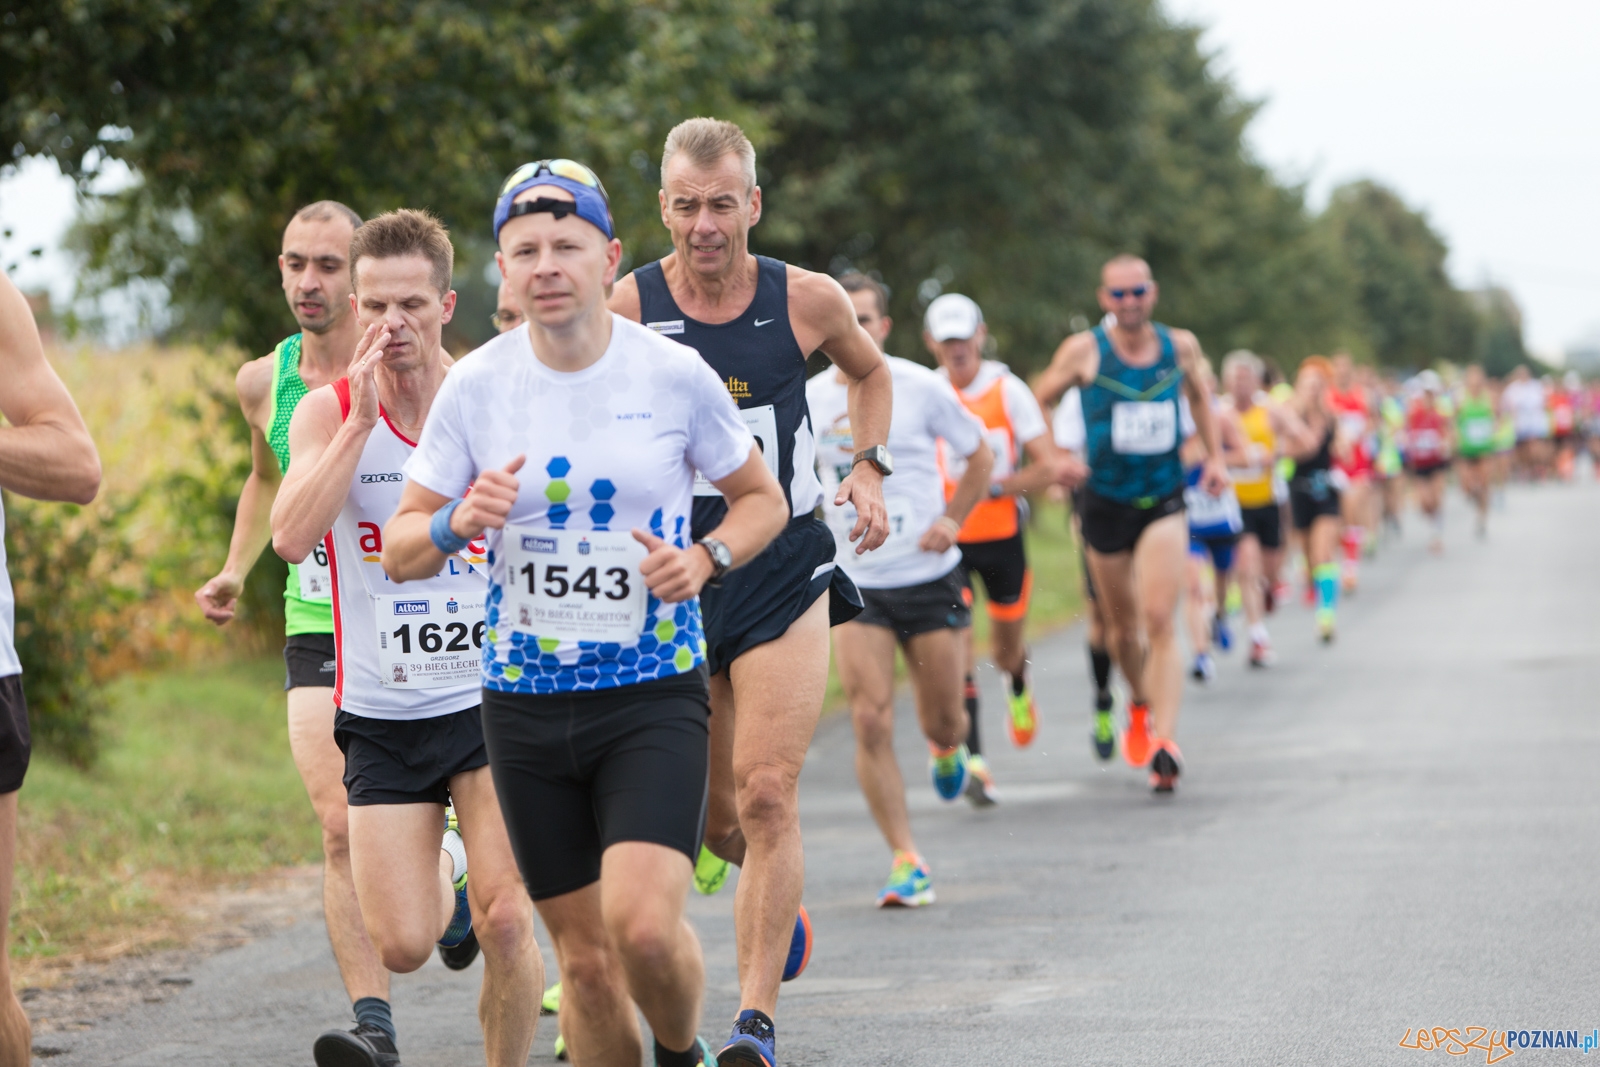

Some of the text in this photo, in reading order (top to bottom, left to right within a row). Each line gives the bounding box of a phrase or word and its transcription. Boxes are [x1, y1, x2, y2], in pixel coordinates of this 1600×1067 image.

[520, 562, 631, 601] 1543
[547, 608, 574, 620] BIEG
[410, 659, 481, 673] 39 BIEG LECHI
